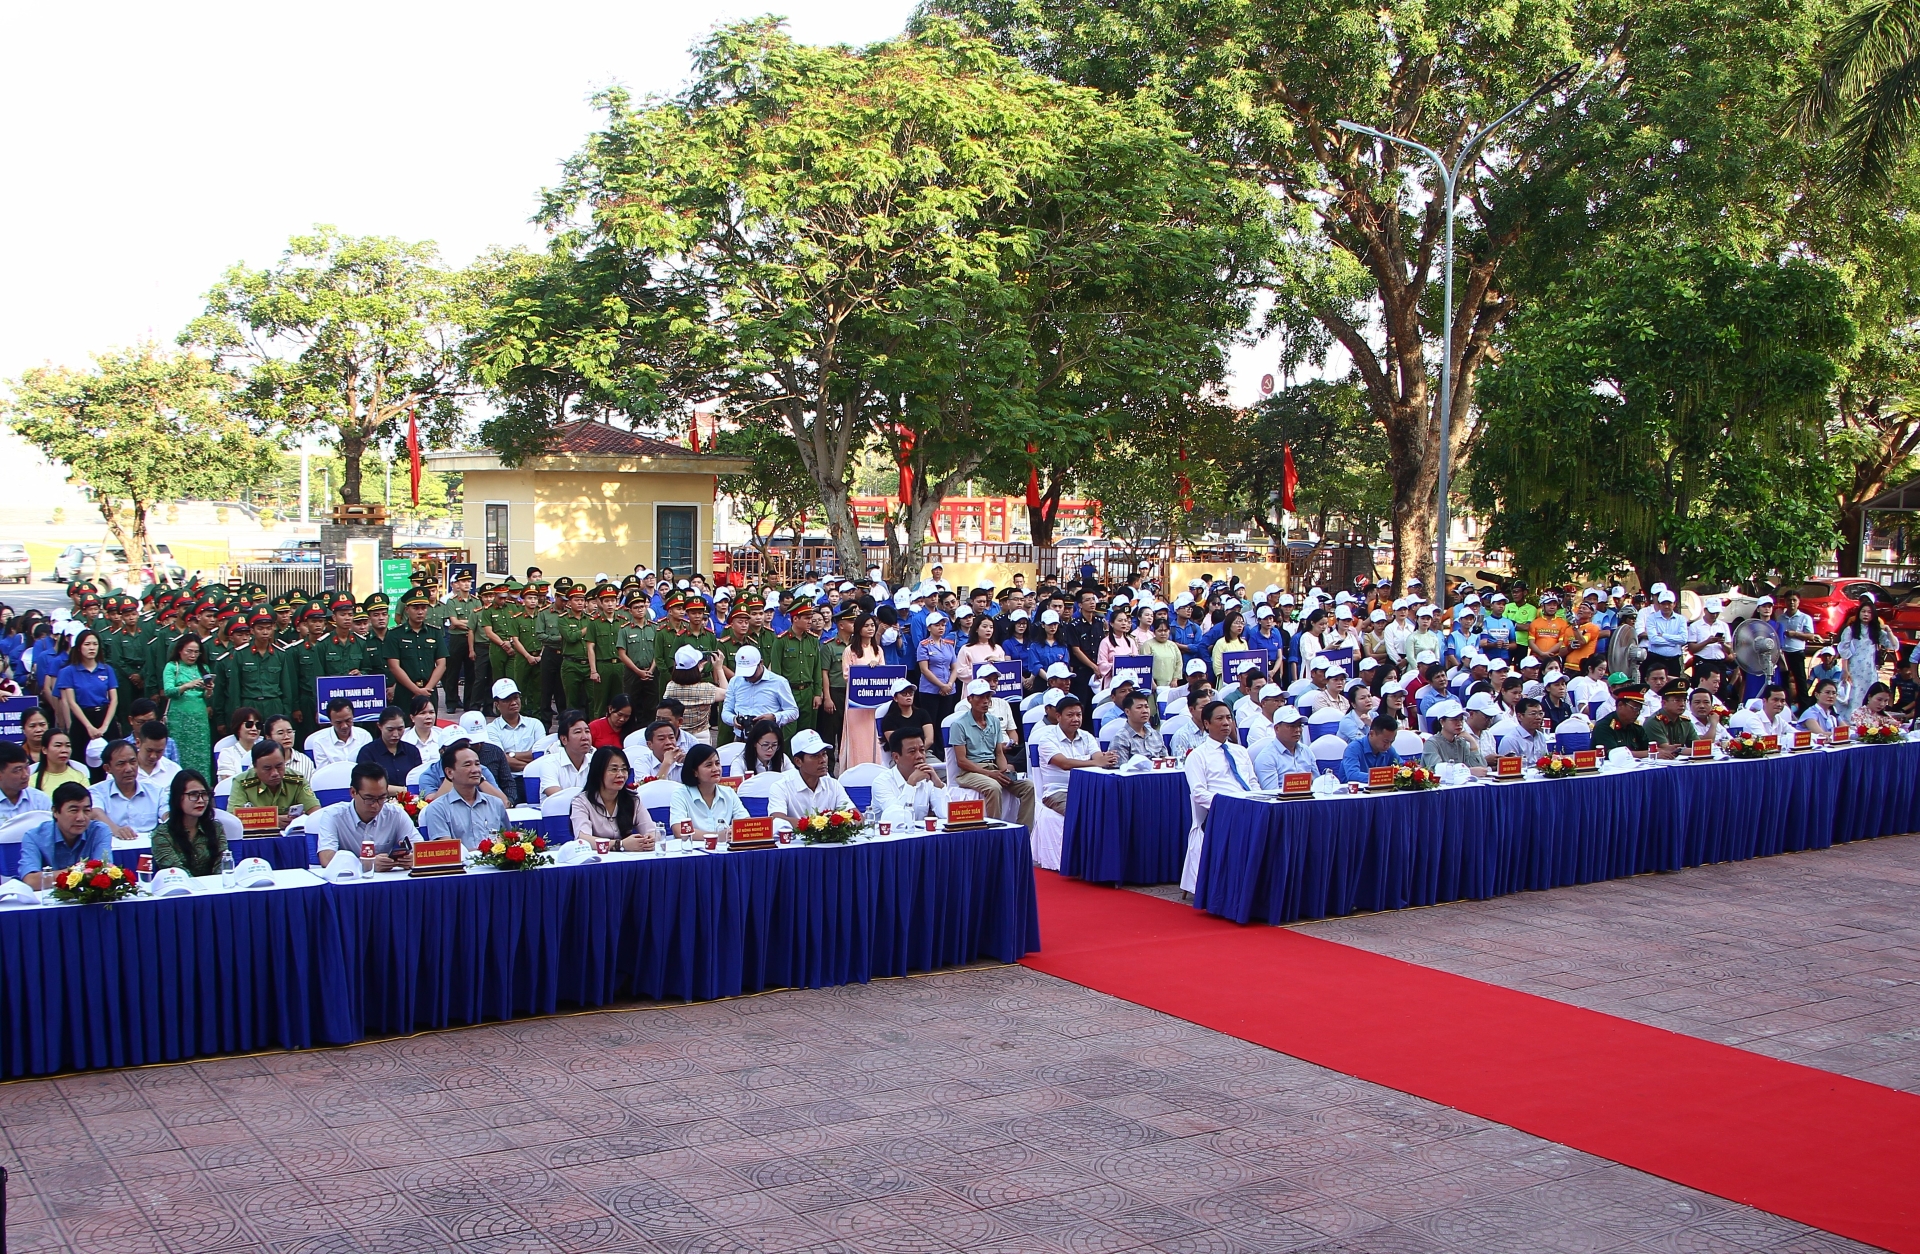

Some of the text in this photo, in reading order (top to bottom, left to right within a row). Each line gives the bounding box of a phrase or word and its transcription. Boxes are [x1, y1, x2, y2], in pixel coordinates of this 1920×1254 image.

[1006, 672, 1015, 680] NIÊN
[852, 677, 868, 686] ĐOÀN
[330, 687, 374, 698] ĐOÀN THANH NIÊN
[858, 688, 874, 697] CÔNG
[352, 700, 363, 709] UÂN
[364, 701, 371, 709] SỰ
[372, 698, 383, 708] TỈNH
